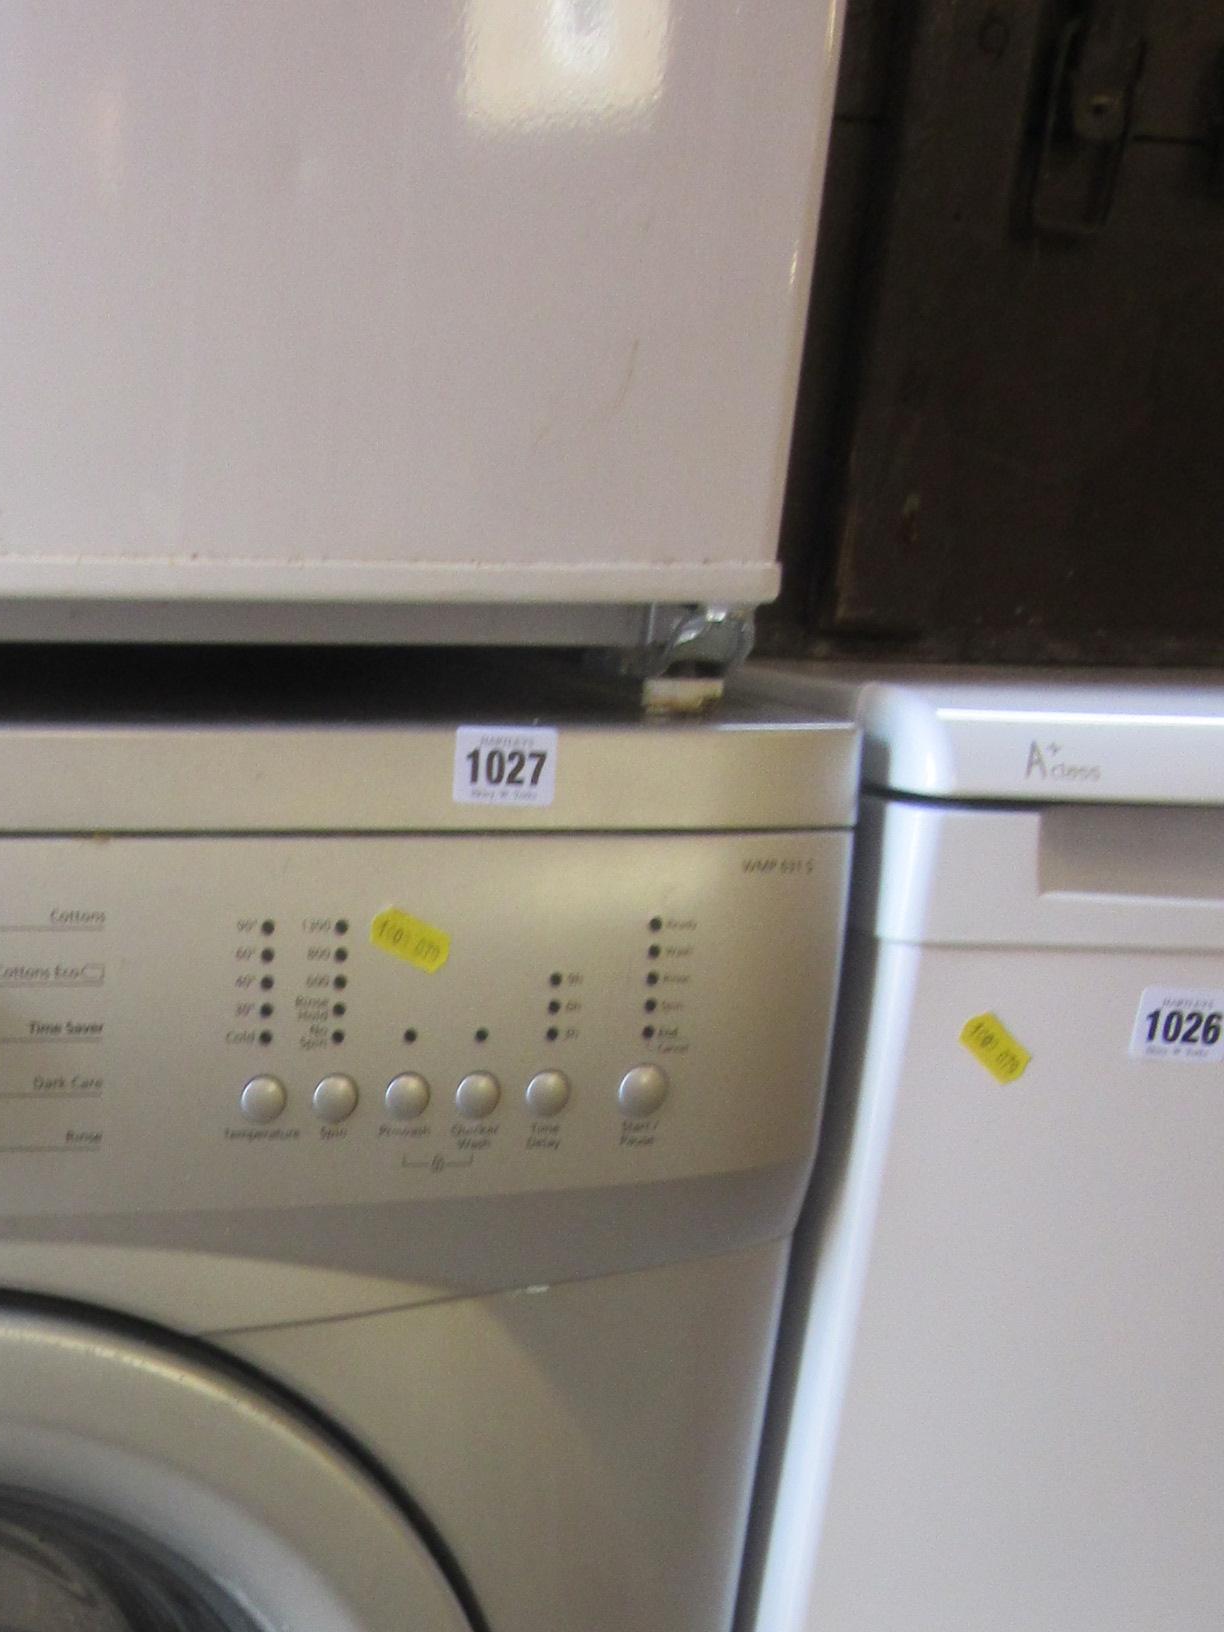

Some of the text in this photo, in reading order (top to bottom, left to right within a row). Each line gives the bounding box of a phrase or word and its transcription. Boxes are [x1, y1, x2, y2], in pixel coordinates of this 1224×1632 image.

[466, 749, 547, 786] 1027
[50, 909, 106, 924] Cottons
[1146, 1008, 1223, 1045] 1026
